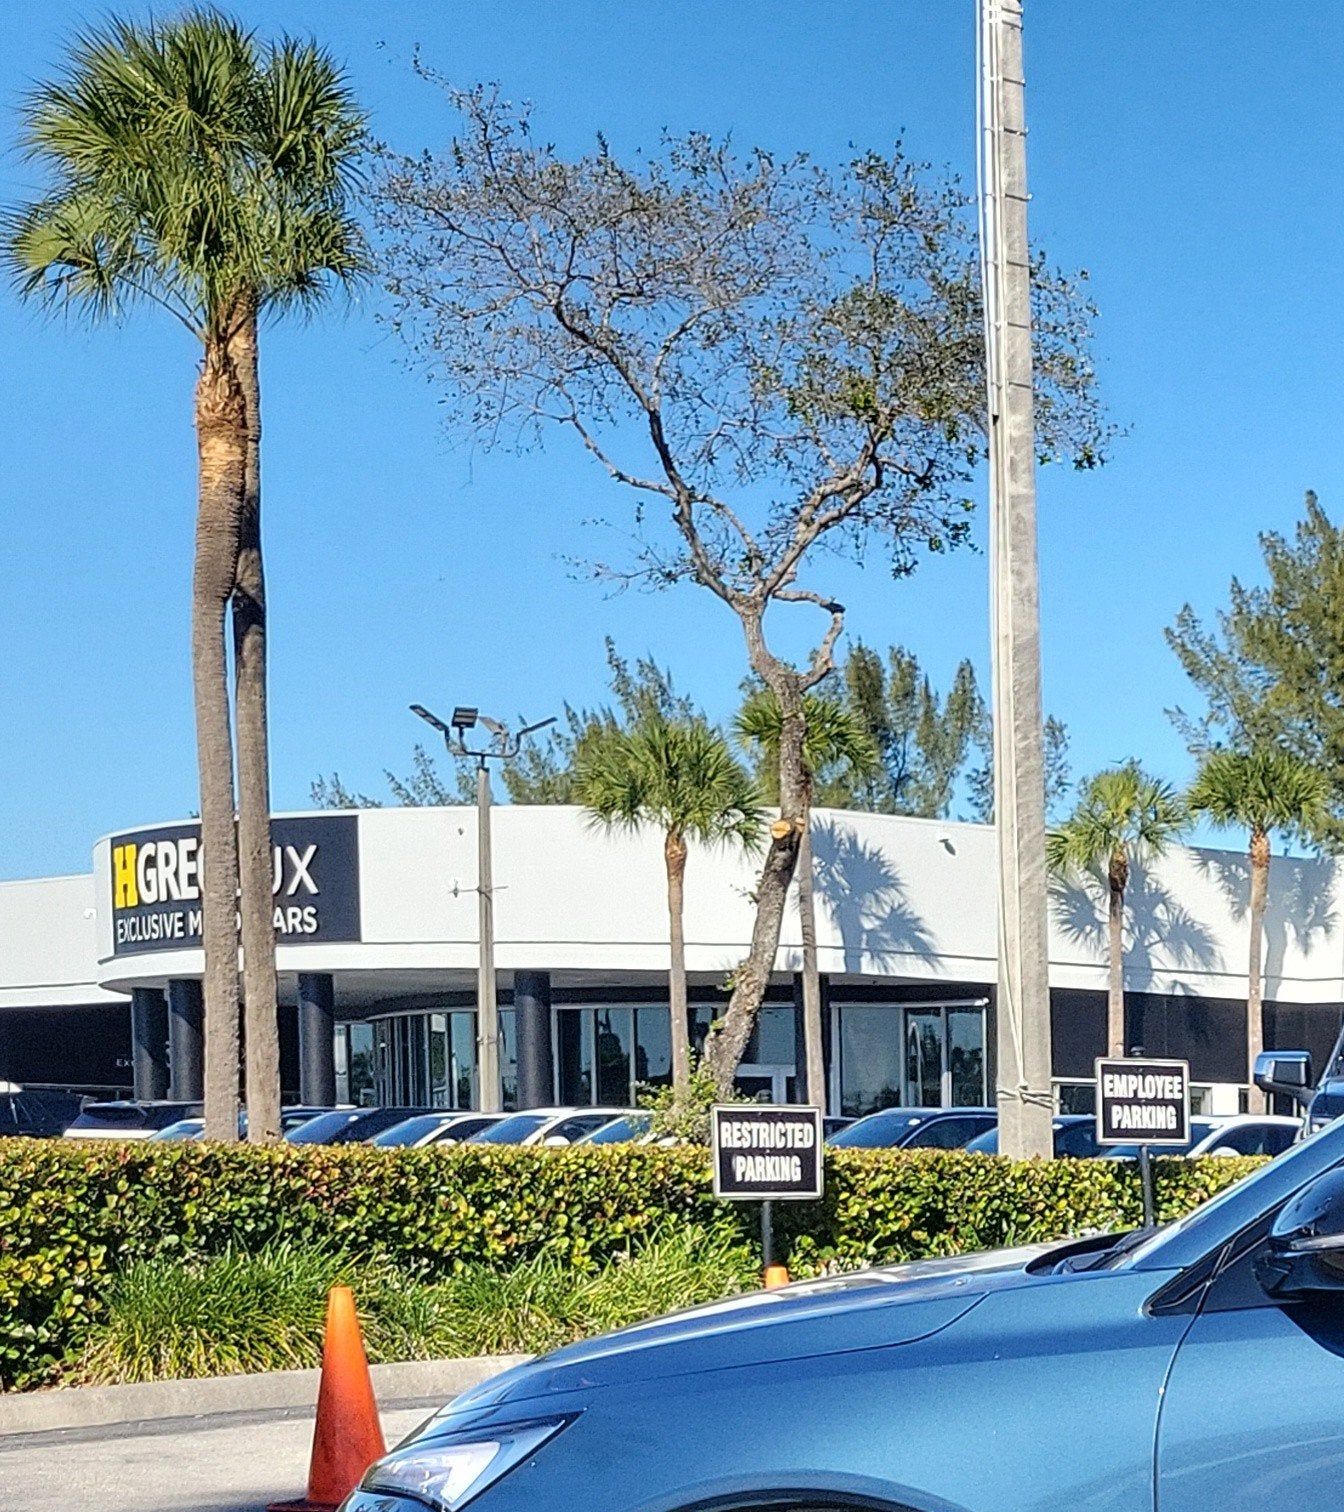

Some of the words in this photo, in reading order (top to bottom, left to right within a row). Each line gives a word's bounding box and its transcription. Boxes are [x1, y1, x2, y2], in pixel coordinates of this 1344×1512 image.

[117, 911, 185, 944] EXCLUSIVE
[1103, 1073, 1183, 1100] EMPLOYEE
[1111, 1104, 1177, 1130] PARKING
[720, 1121, 815, 1149] RESTRICTED
[735, 1154, 802, 1183] PARKING
